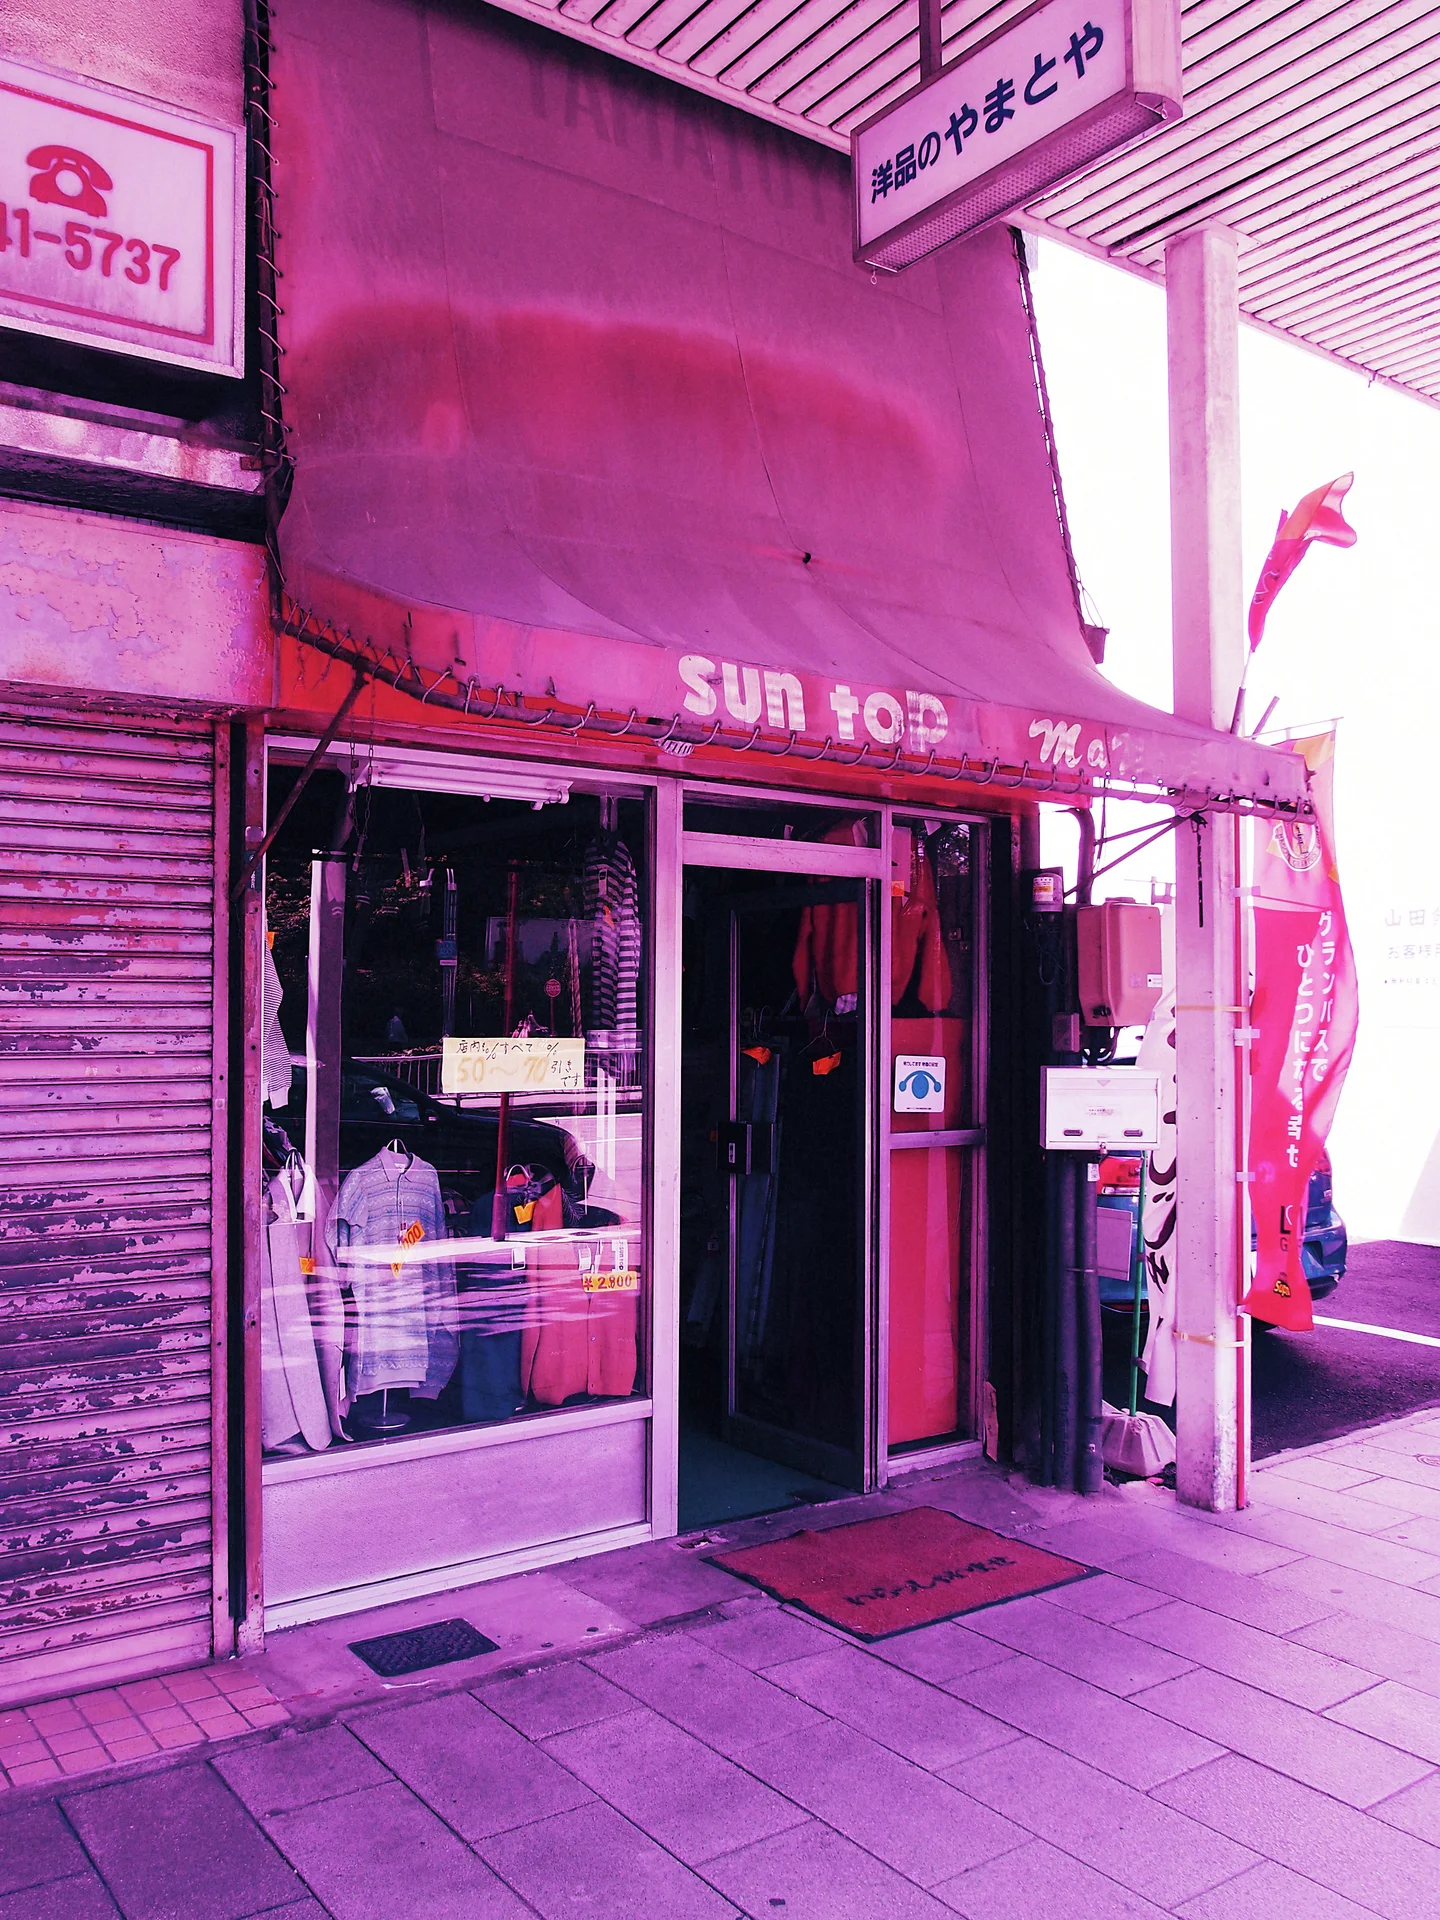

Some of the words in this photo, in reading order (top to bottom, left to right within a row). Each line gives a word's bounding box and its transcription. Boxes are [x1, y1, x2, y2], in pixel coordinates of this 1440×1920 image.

[871, 21, 1104, 204] 洋品のやまとや
[1311, 912, 1336, 1082] グランパスで
